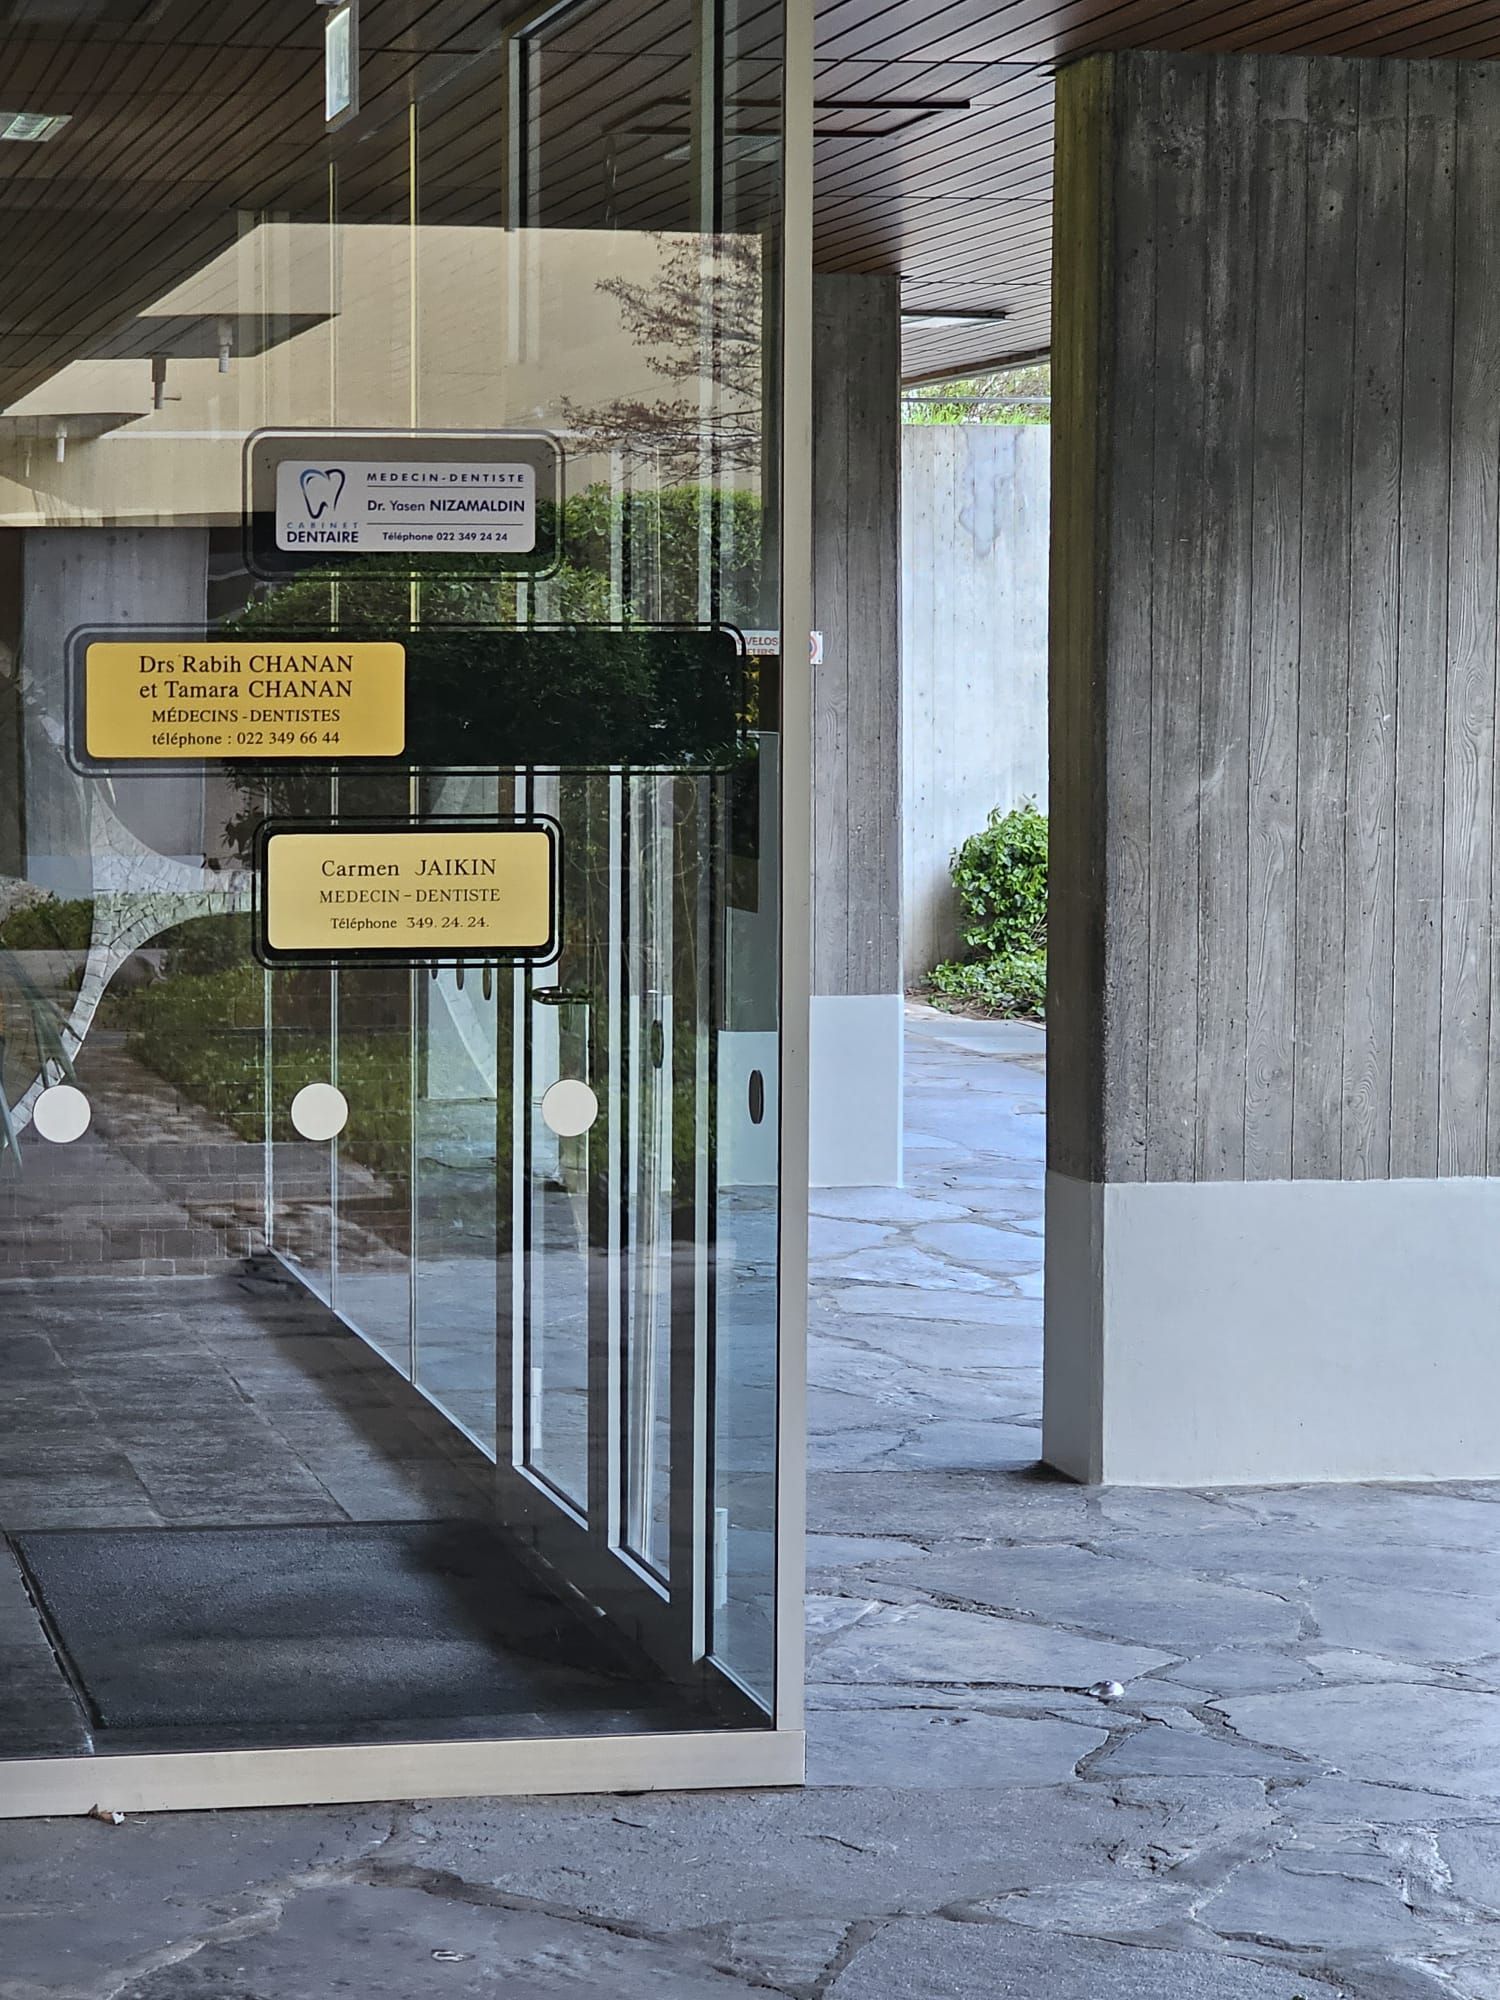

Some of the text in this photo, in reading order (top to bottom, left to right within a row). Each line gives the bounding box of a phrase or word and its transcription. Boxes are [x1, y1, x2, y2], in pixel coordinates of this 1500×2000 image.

[367, 499, 525, 512] Dr. Yasen NIZAMALDIN
[286, 522, 359, 530] CABINET
[286, 531, 360, 543] DENTAIRE
[382, 531, 508, 542] Téléphone 022 349 24 24
[139, 655, 353, 673] Drs Rabih CHANAN
[139, 680, 352, 698] et Tamara CHANAN
[152, 732, 222, 748] téléphone
[237, 732, 264, 745] 022
[269, 732, 295, 744] 349
[300, 732, 318, 744] 66
[322, 732, 340, 744] 44
[321, 859, 497, 877] Carmen JAIKIN
[330, 917, 397, 931] Téléphone
